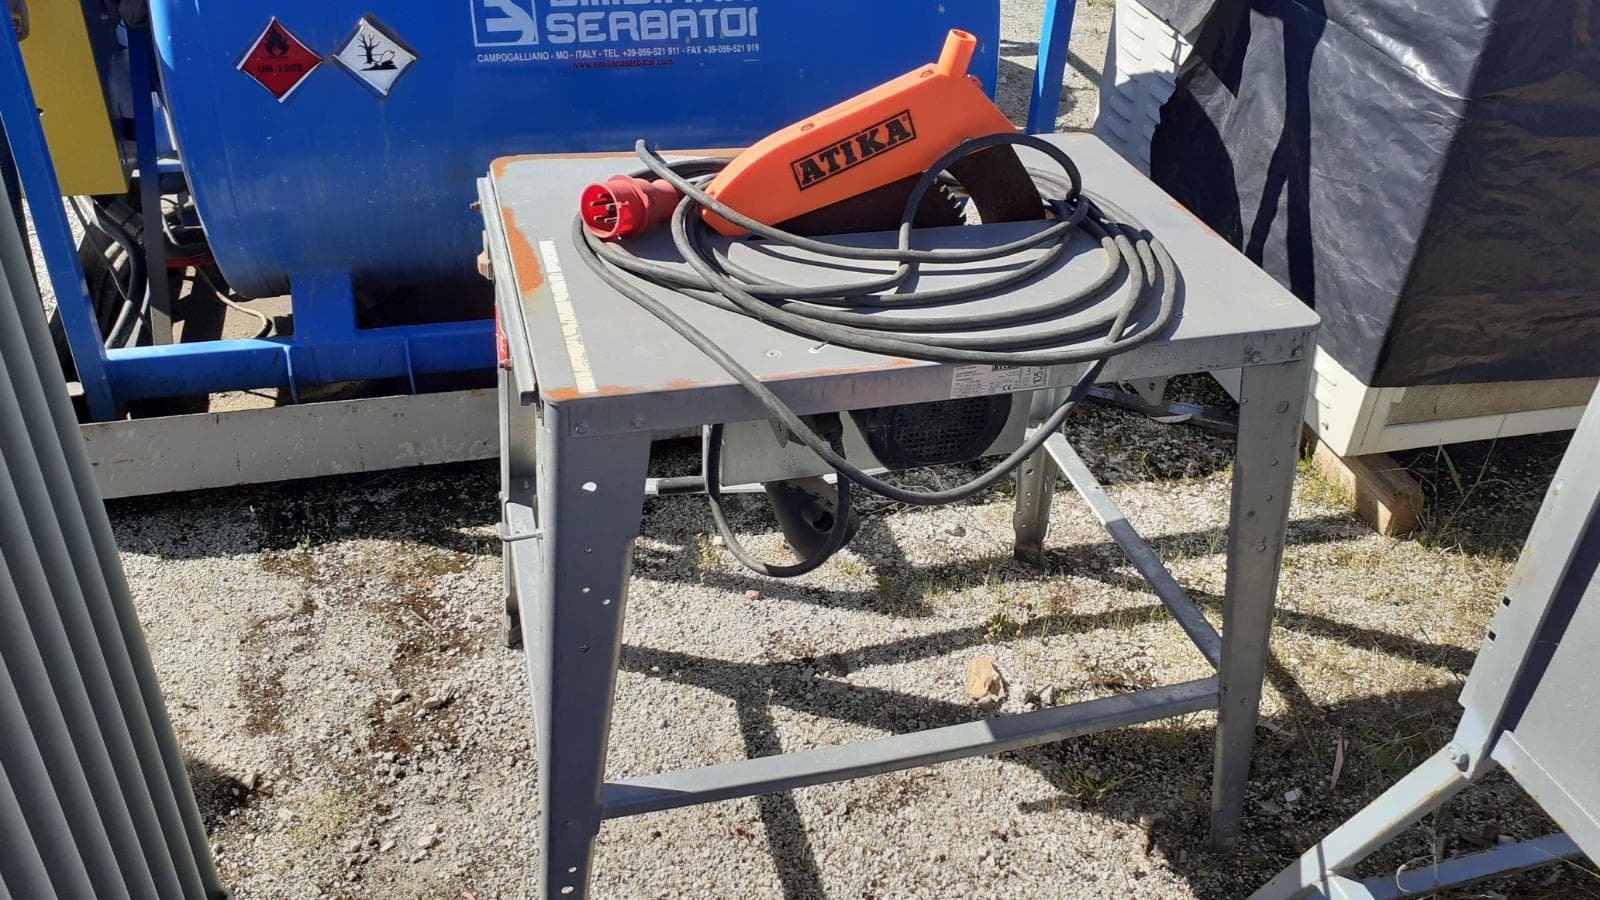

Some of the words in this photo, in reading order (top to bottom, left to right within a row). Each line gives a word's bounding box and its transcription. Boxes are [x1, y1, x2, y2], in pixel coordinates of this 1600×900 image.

[546, 6, 758, 44] SERBATOI
[477, 51, 549, 63] CAMPOGALLIANO
[556, 50, 569, 60] MO
[575, 49, 597, 59] ITALY
[622, 46, 665, 57] +39-059-521
[668, 46, 680, 56] 911
[686, 45, 701, 54] FAX
[703, 43, 745, 54] +39-059-521
[747, 43, 760, 52] 919
[258, 64, 273, 73] UN
[799, 118, 911, 186] ATIKA
